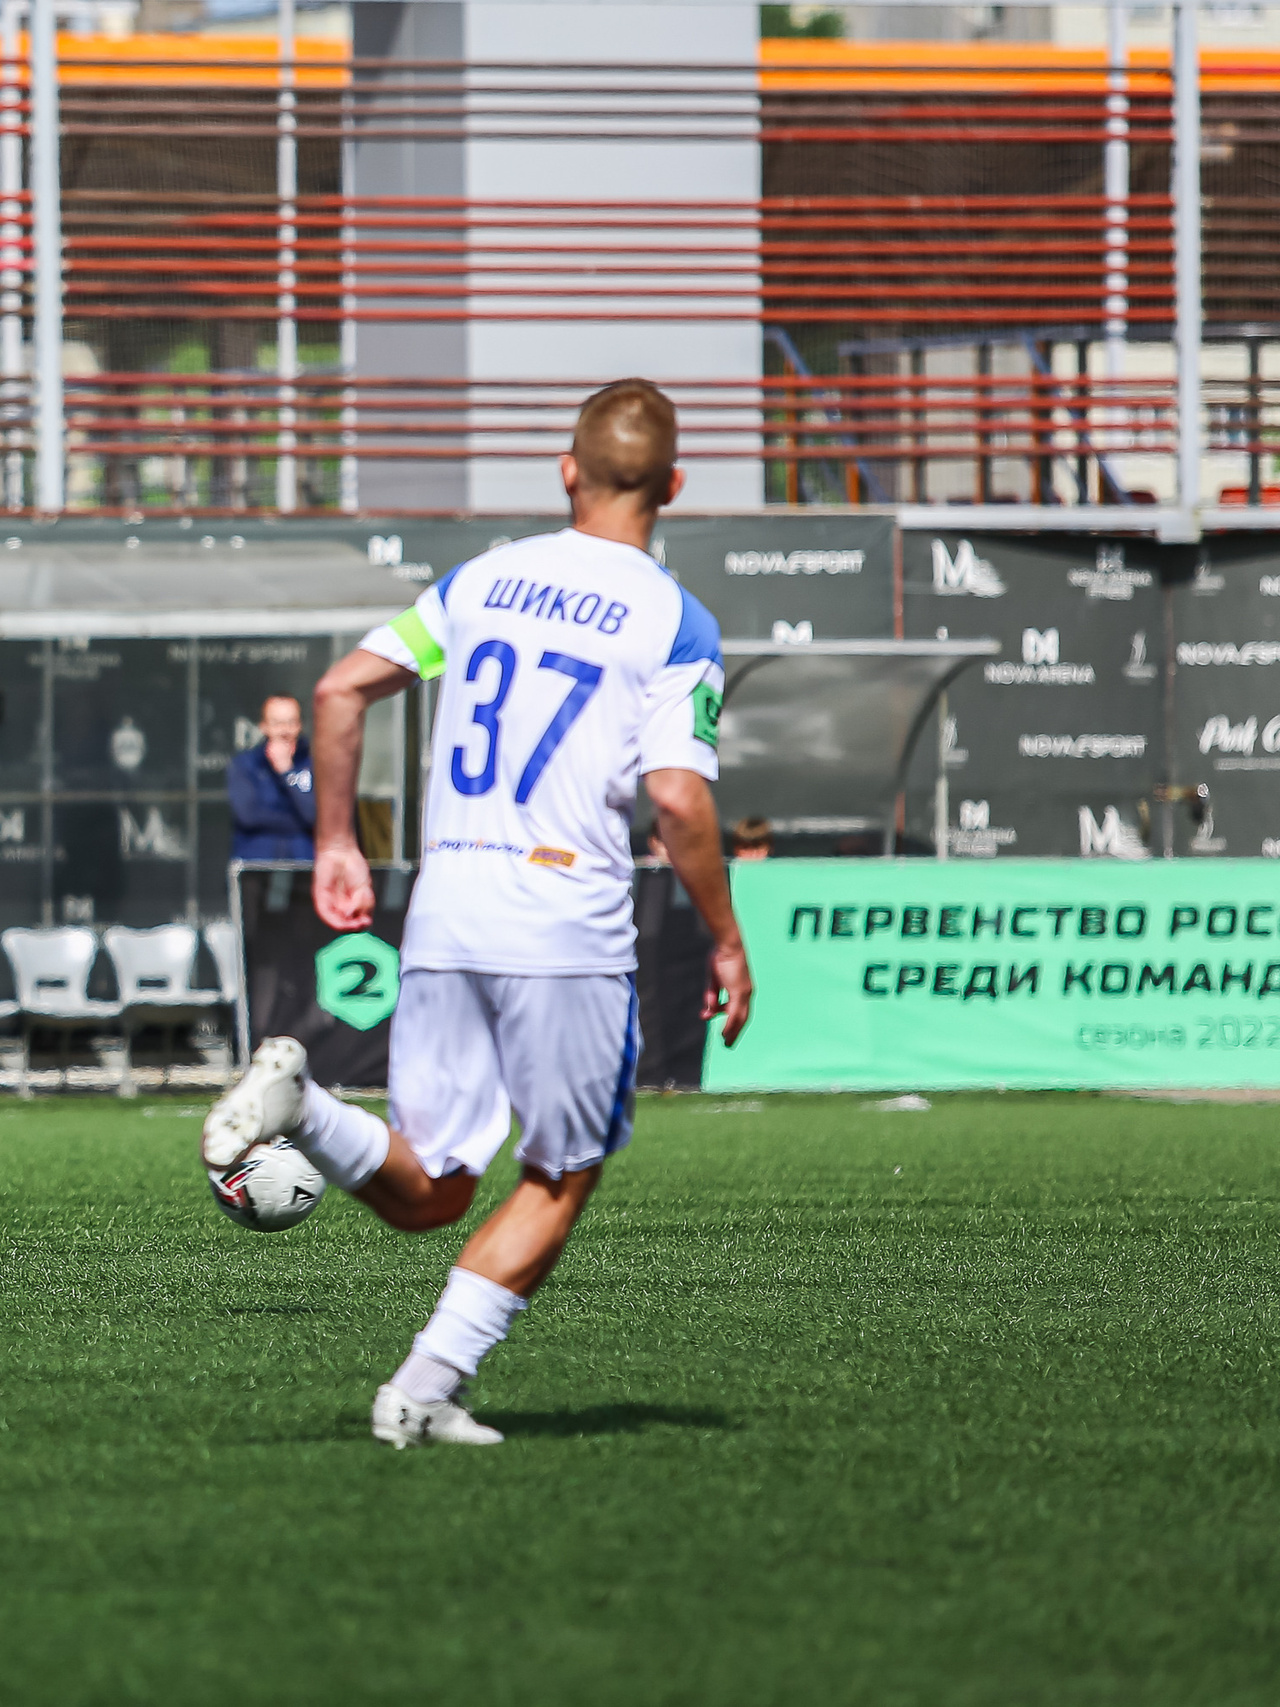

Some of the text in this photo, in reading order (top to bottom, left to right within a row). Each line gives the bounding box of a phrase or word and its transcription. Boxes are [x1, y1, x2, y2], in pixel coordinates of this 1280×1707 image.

[484, 579, 628, 634] ШИКОВ
[451, 640, 603, 804] 37
[789, 905, 1146, 939] ПЕРВЕНСТВО
[337, 960, 385, 998] 2
[862, 962, 1040, 1000] СРЕДИ
